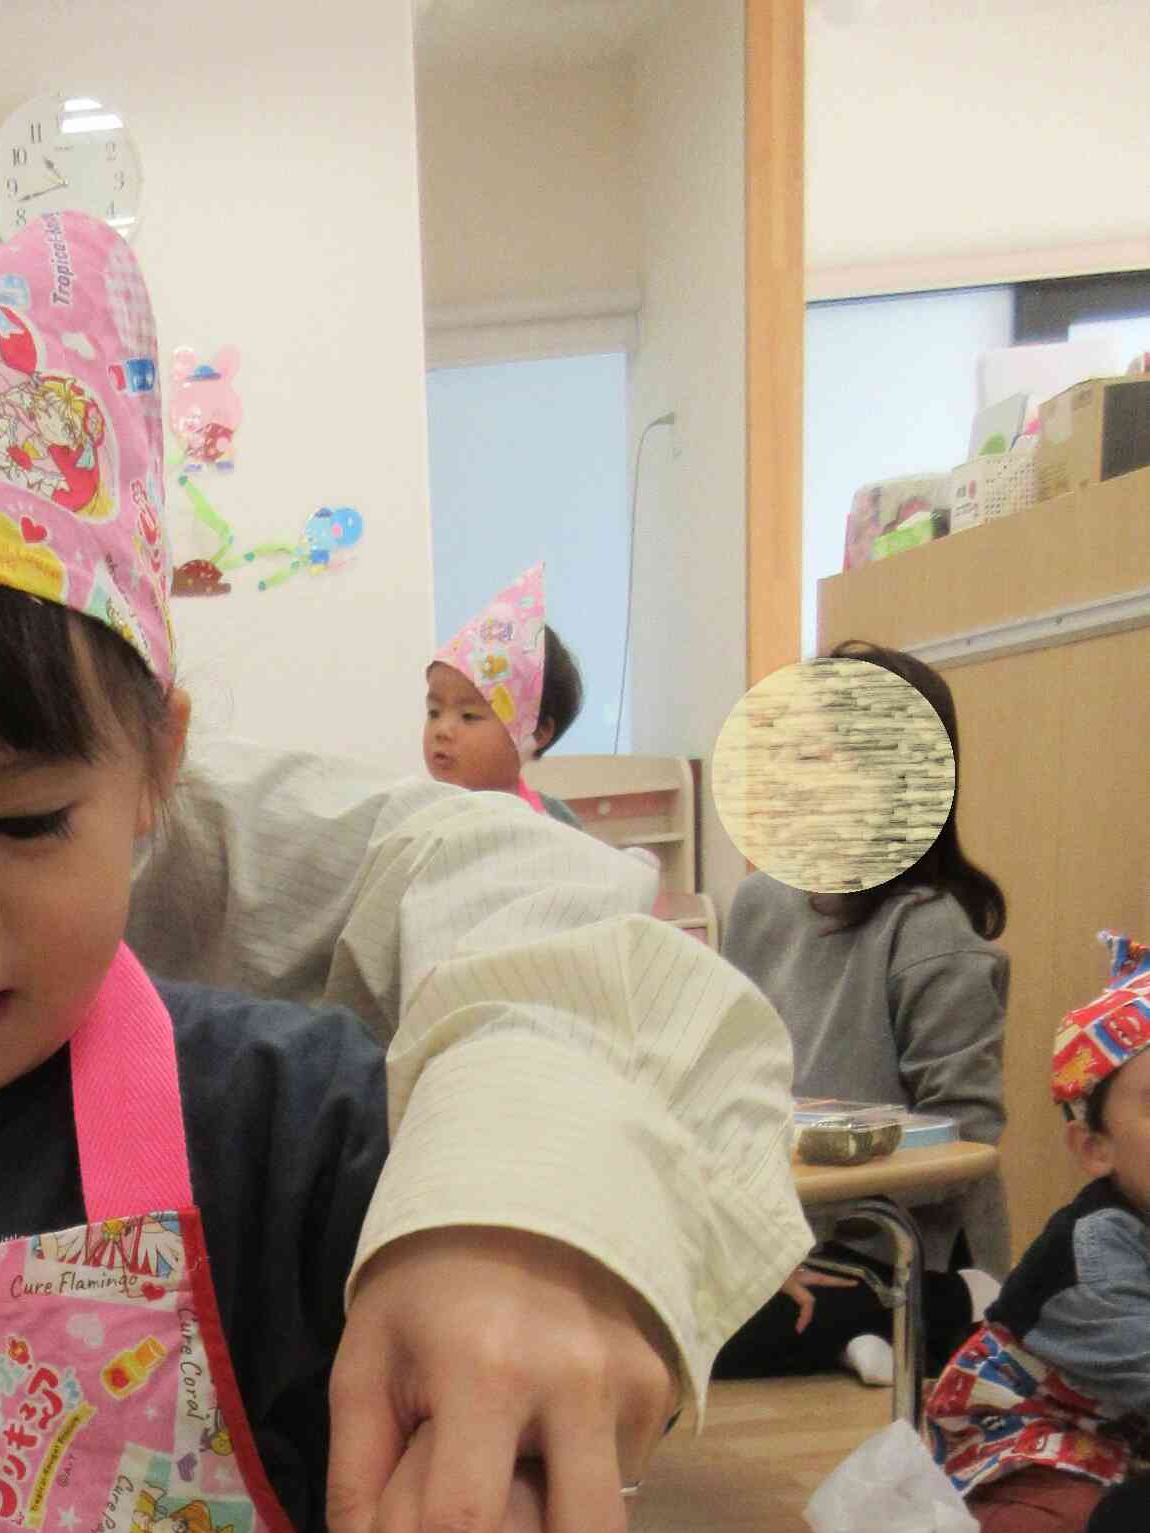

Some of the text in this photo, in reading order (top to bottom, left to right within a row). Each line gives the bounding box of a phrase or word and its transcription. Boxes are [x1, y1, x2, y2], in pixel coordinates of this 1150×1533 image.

[29, 119, 43, 143] 11
[11, 146, 28, 167] 10
[5, 177, 19, 198] 9
[15, 206, 28, 226] 8
[9, 1271, 139, 1298] Cure Flamingo
[181, 1361, 207, 1421] Coral
[105, 1475, 134, 1511] Cure
